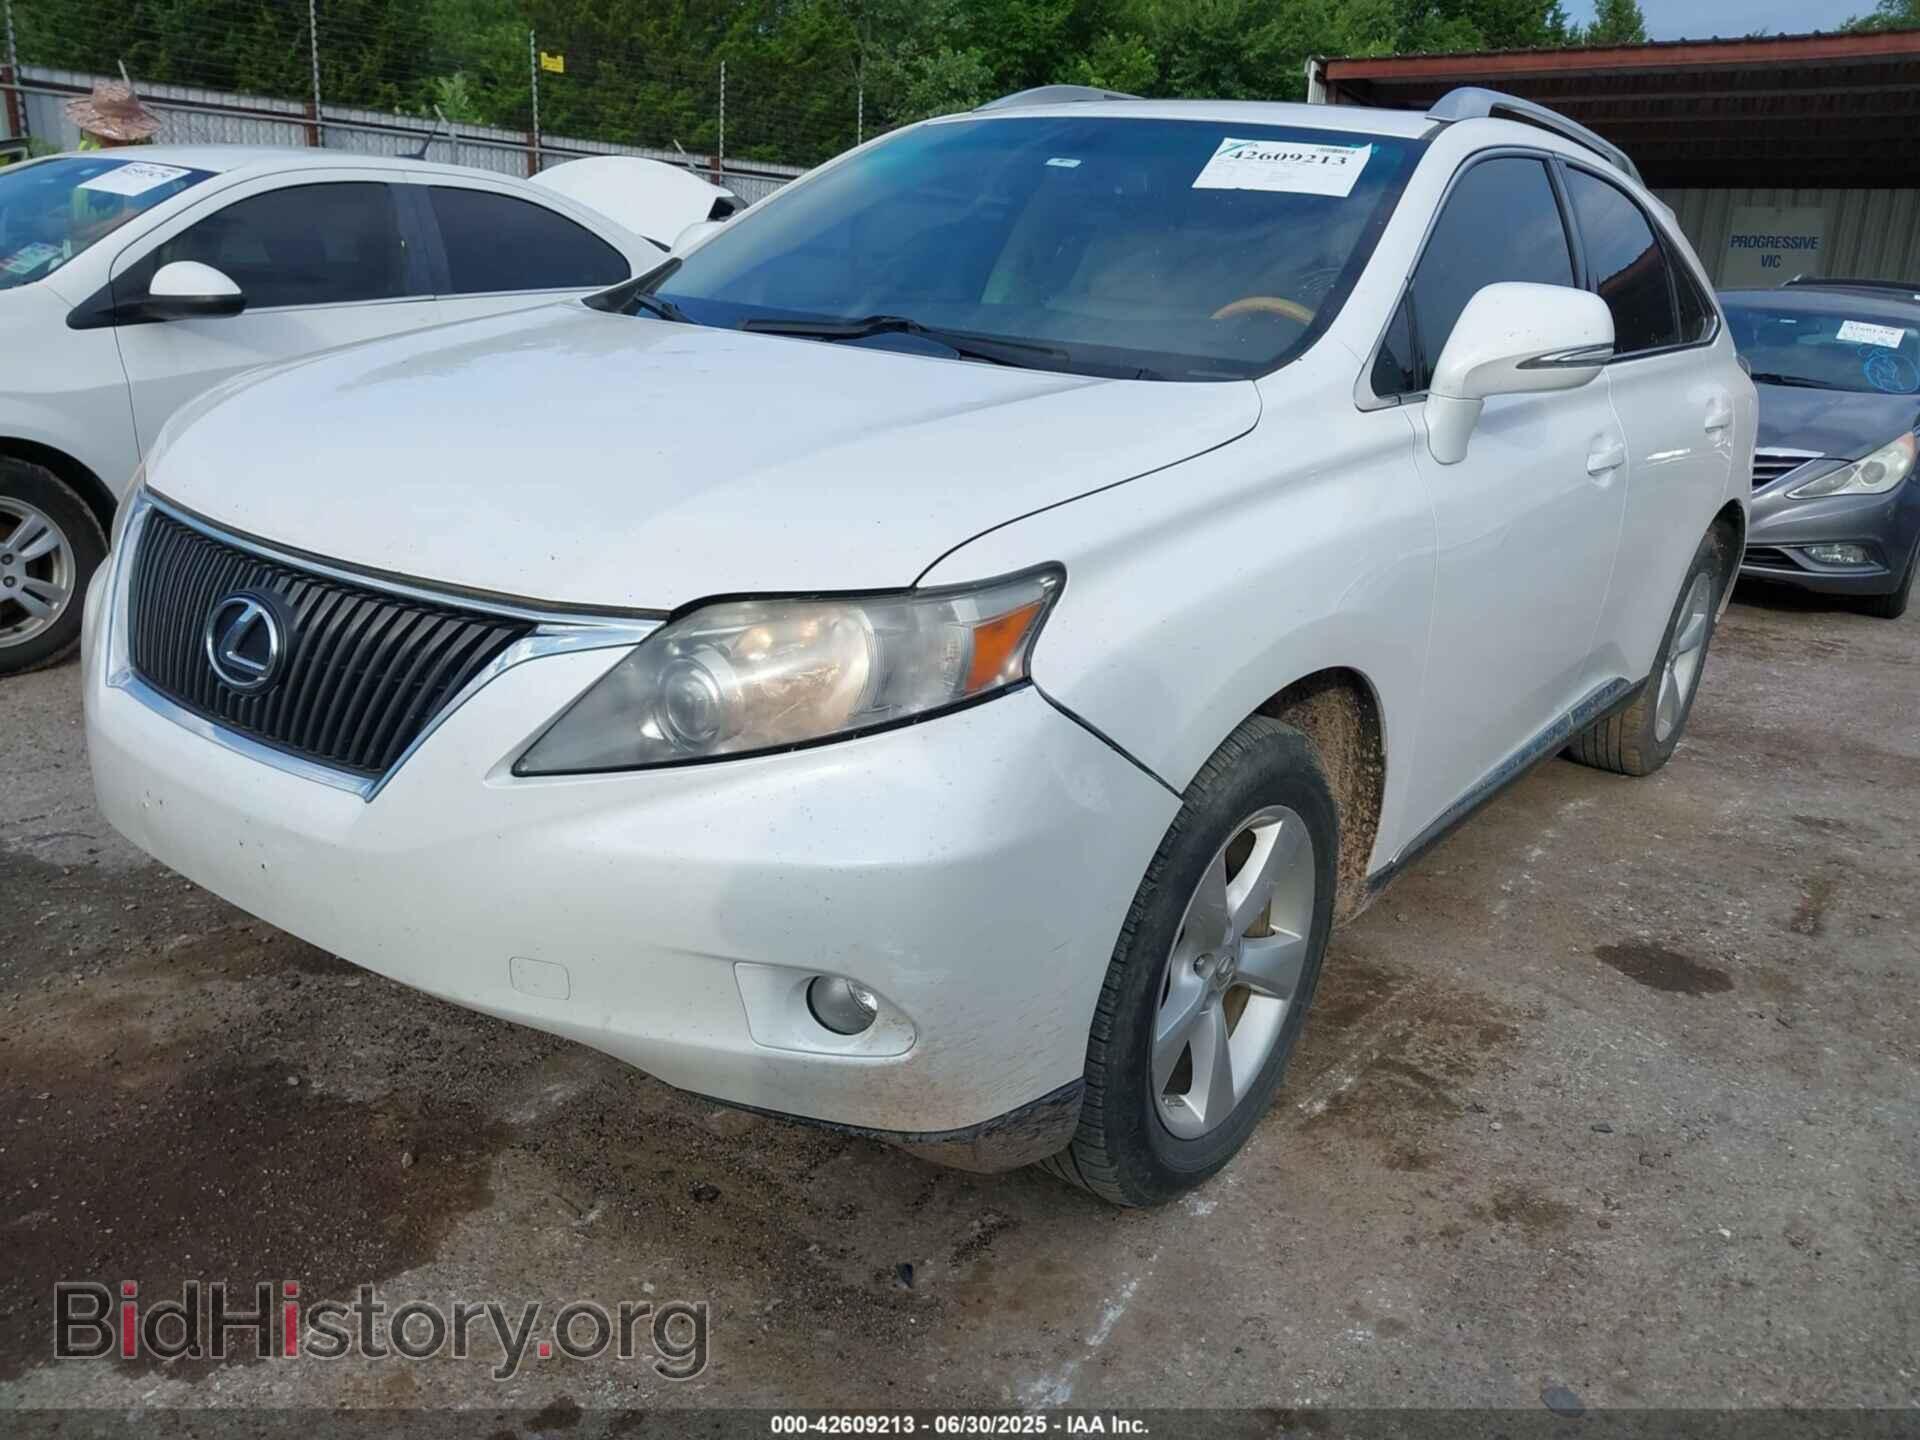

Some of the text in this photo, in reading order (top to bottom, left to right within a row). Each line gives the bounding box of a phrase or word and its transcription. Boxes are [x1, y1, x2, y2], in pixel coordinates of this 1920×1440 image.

[1229, 149, 1348, 166] 42609213
[1730, 235, 1819, 250] PROGRESSIVE
[1760, 254, 1782, 269] VIC
